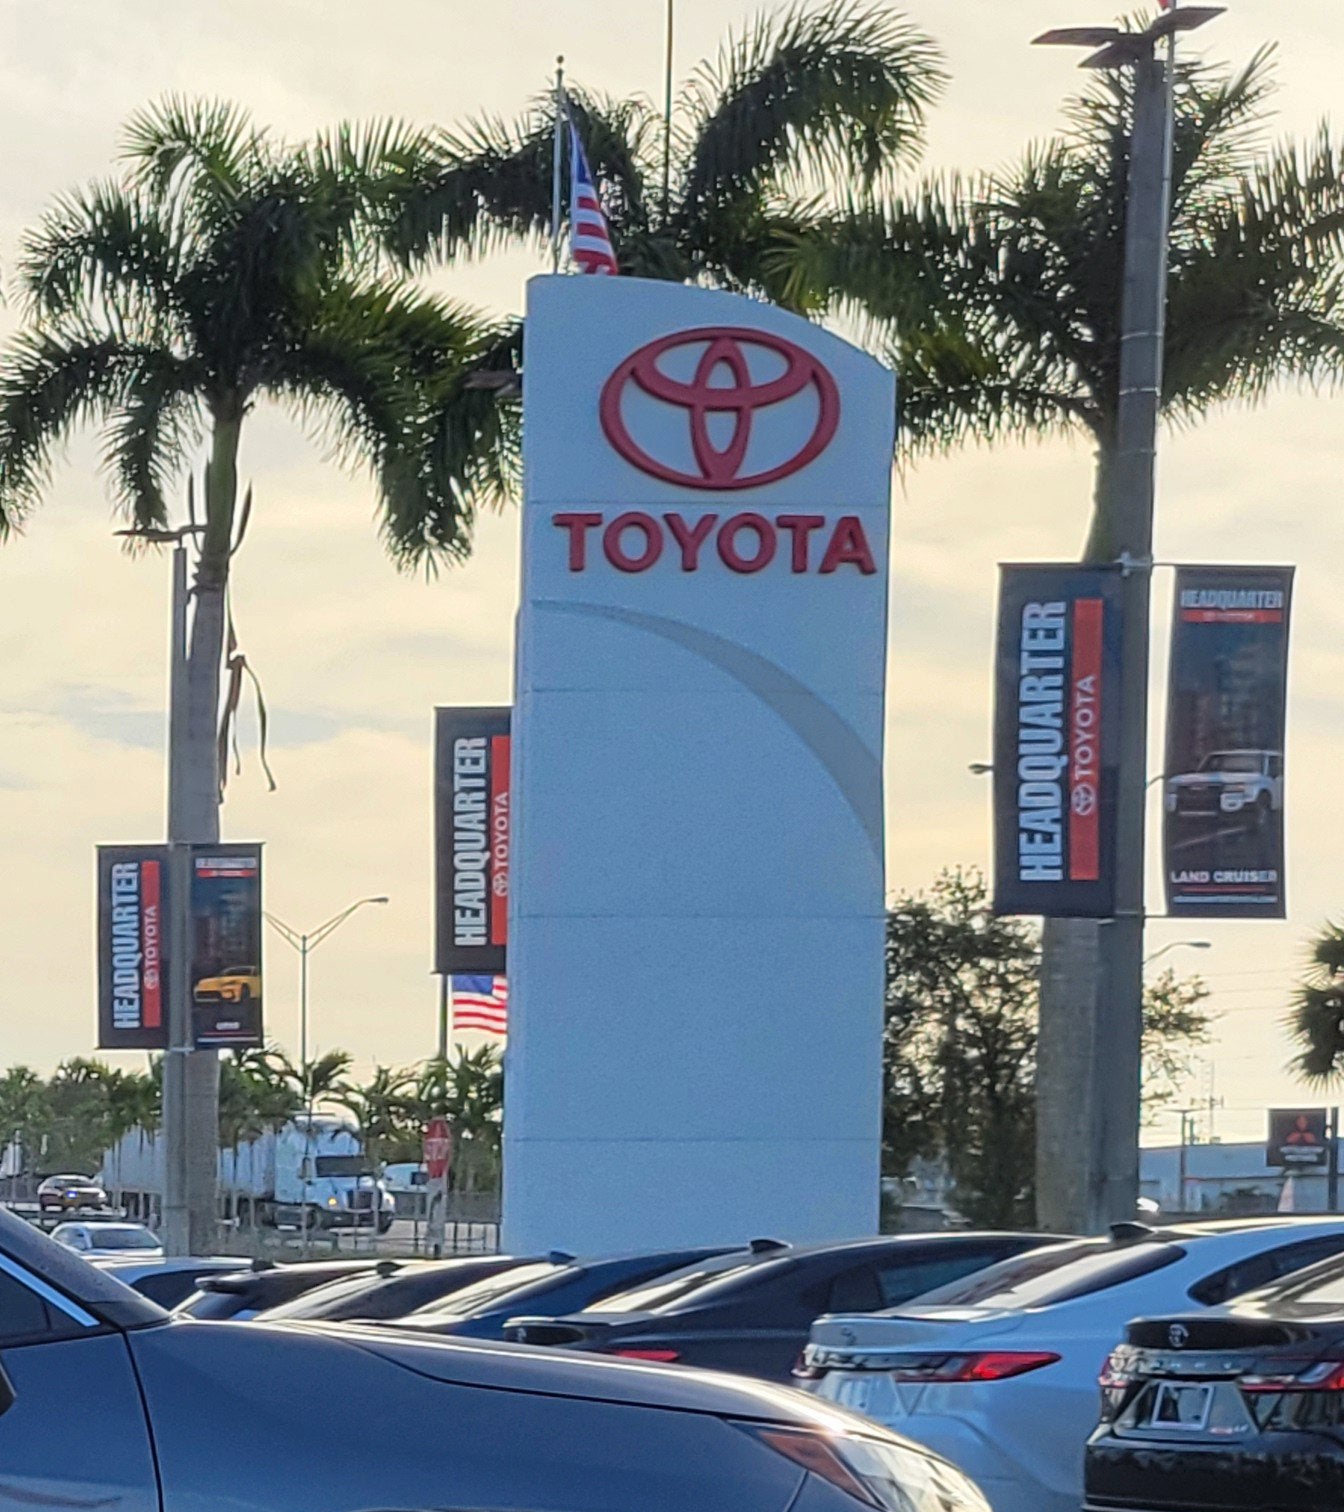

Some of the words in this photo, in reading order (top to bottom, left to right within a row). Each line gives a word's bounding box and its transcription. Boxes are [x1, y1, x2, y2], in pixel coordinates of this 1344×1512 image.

[552, 511, 877, 575] TOYOTA
[1018, 601, 1069, 882] HEADQUARTER
[1074, 675, 1097, 781] TOYOTA
[453, 737, 491, 947] HEADQUARTER
[494, 793, 509, 869] TOYOTA
[1171, 871, 1210, 883] LAND
[112, 862, 144, 1029] HEADQUARTER
[143, 905, 157, 968] TOYOTA
